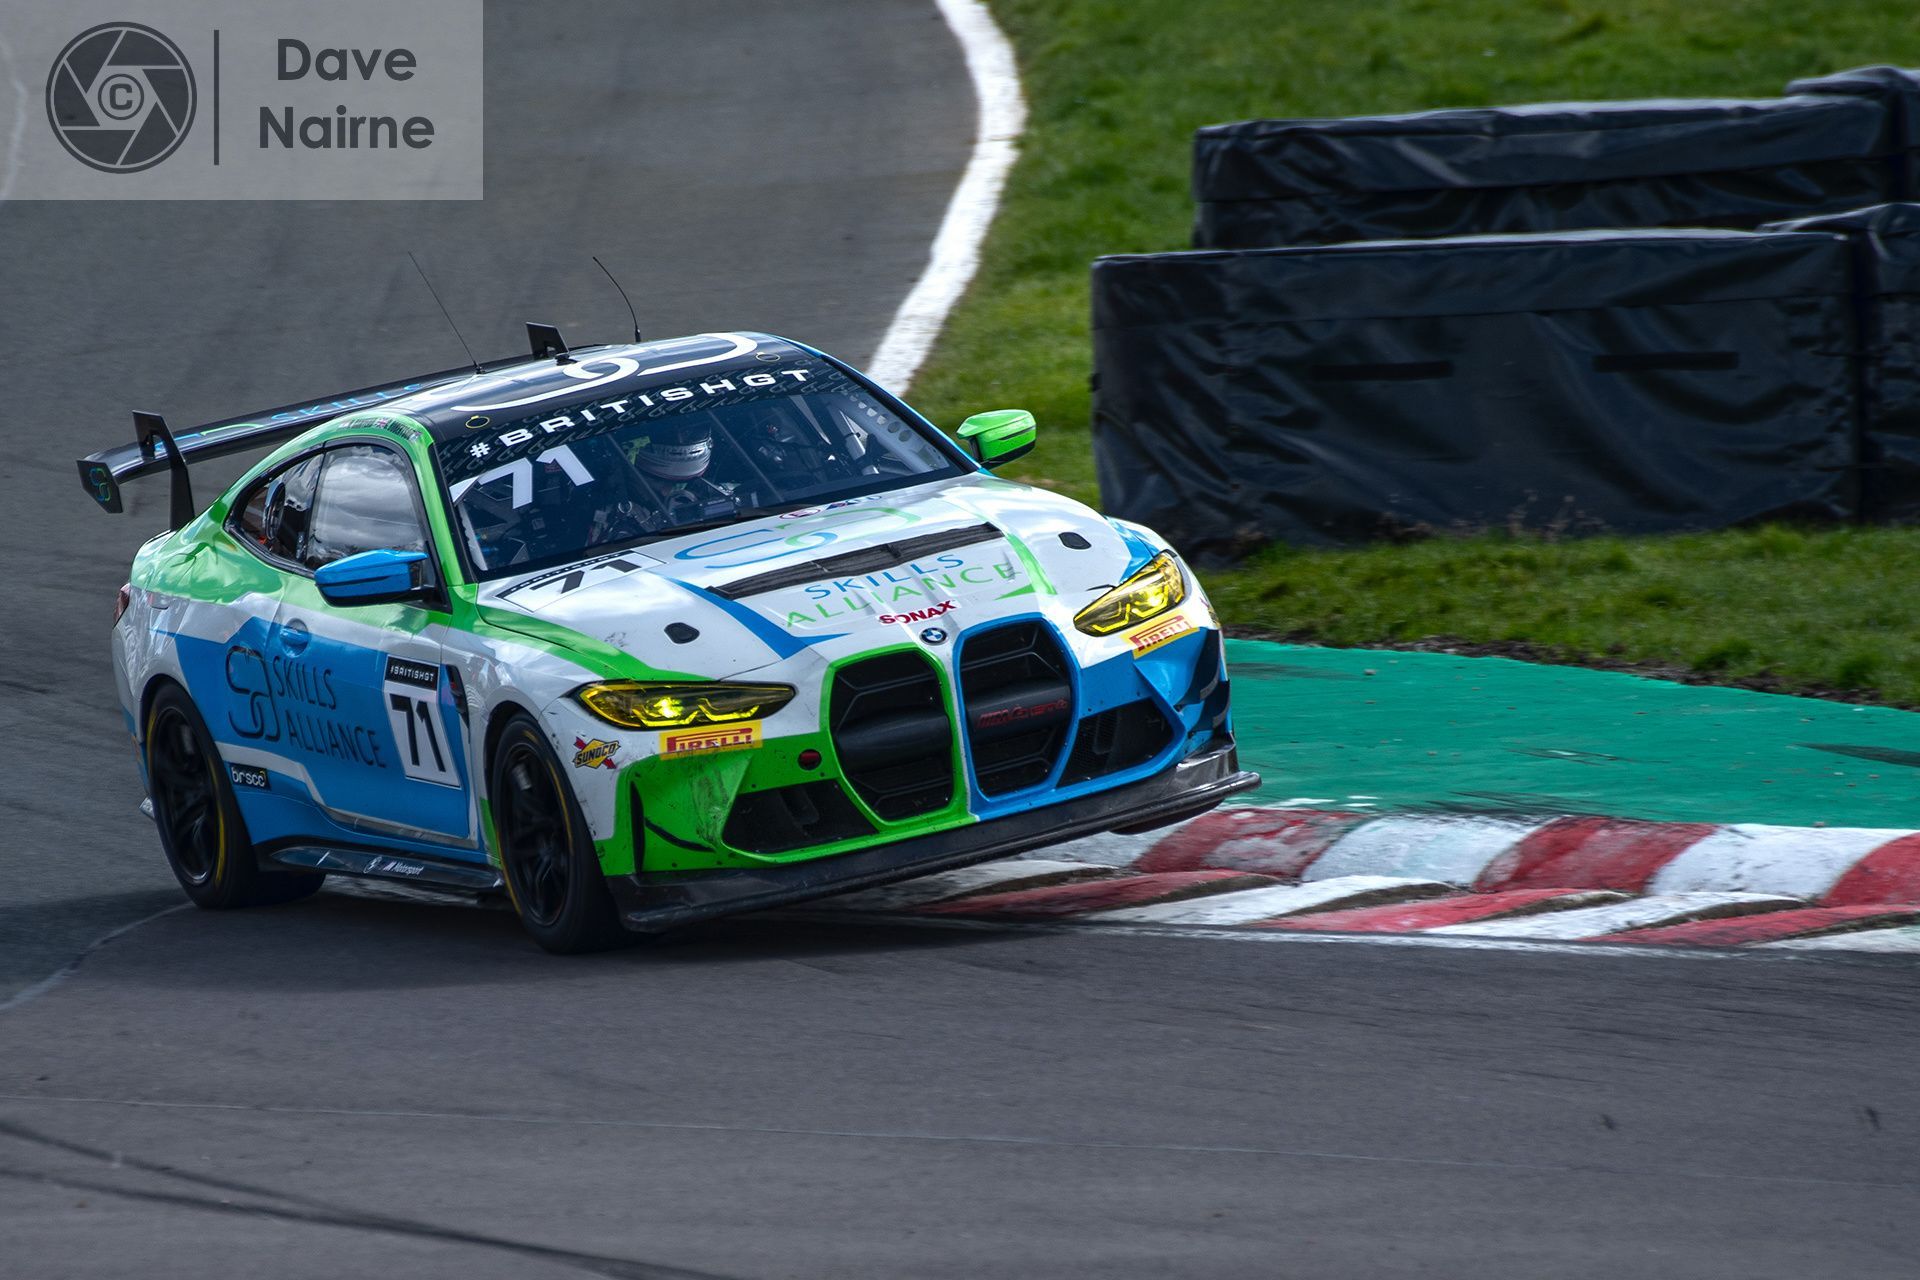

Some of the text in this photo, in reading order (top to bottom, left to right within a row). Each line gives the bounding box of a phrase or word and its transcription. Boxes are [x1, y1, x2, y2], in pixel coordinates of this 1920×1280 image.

[470, 369, 809, 458] #BRITISHGT
[449, 444, 595, 509] 71
[529, 558, 642, 594] 71
[786, 562, 1022, 628] ALLIANCE
[804, 554, 964, 600] SKILLS
[879, 600, 957, 624] SONAX
[1129, 615, 1193, 652] PIRELLI
[272, 655, 337, 711] SKILLS
[285, 709, 388, 769] ALLIANCE
[389, 692, 447, 773] 71
[574, 741, 619, 766] SUNOCO
[667, 727, 753, 753] PIRELLI
[231, 766, 266, 787] brscc
